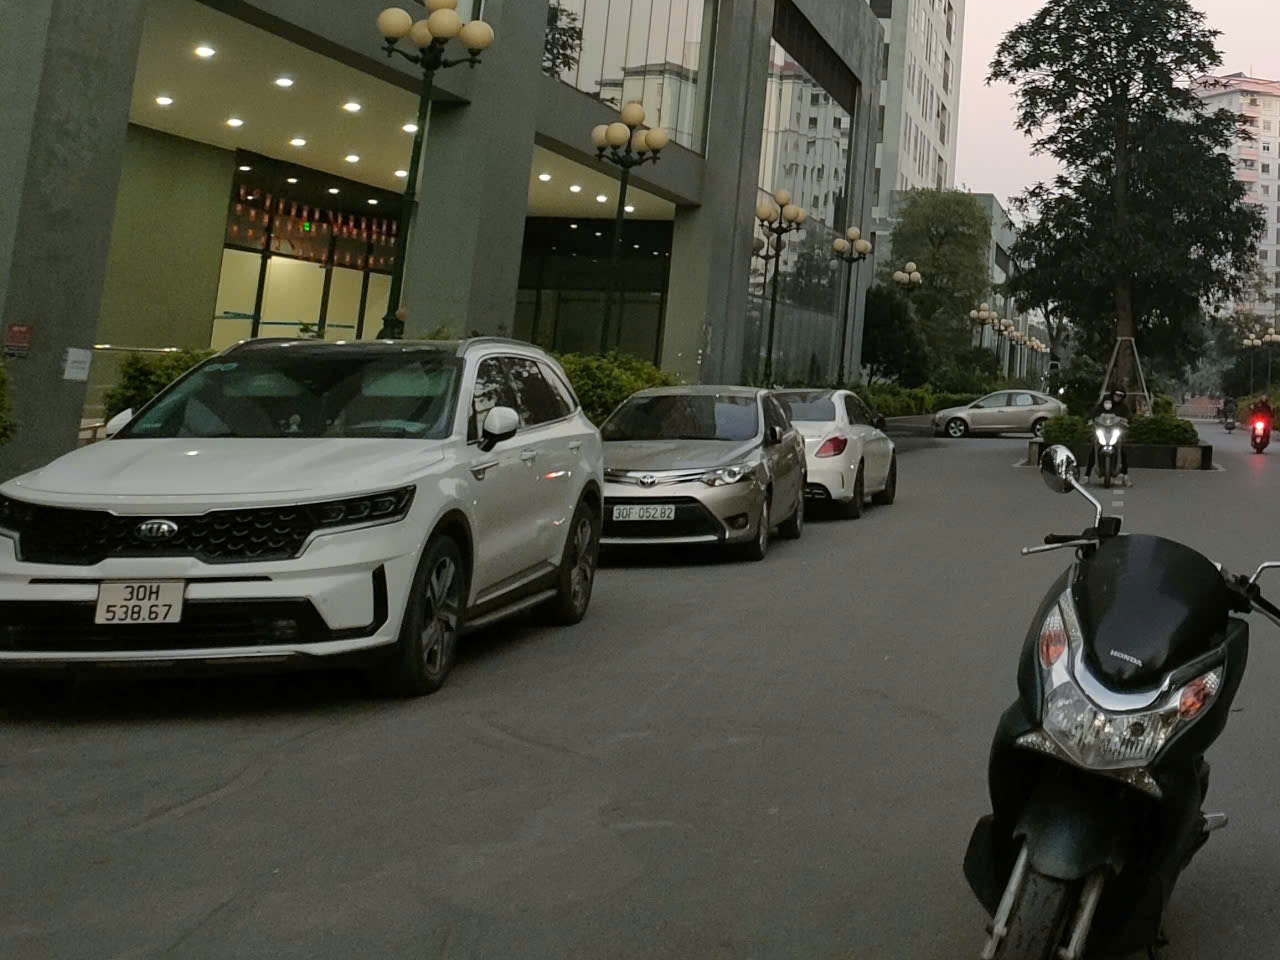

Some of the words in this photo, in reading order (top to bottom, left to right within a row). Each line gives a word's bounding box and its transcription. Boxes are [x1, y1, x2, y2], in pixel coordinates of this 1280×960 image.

[123, 585, 160, 602] 30H
[105, 604, 173, 622] 538.67
[1110, 649, 1143, 668] HONDA
